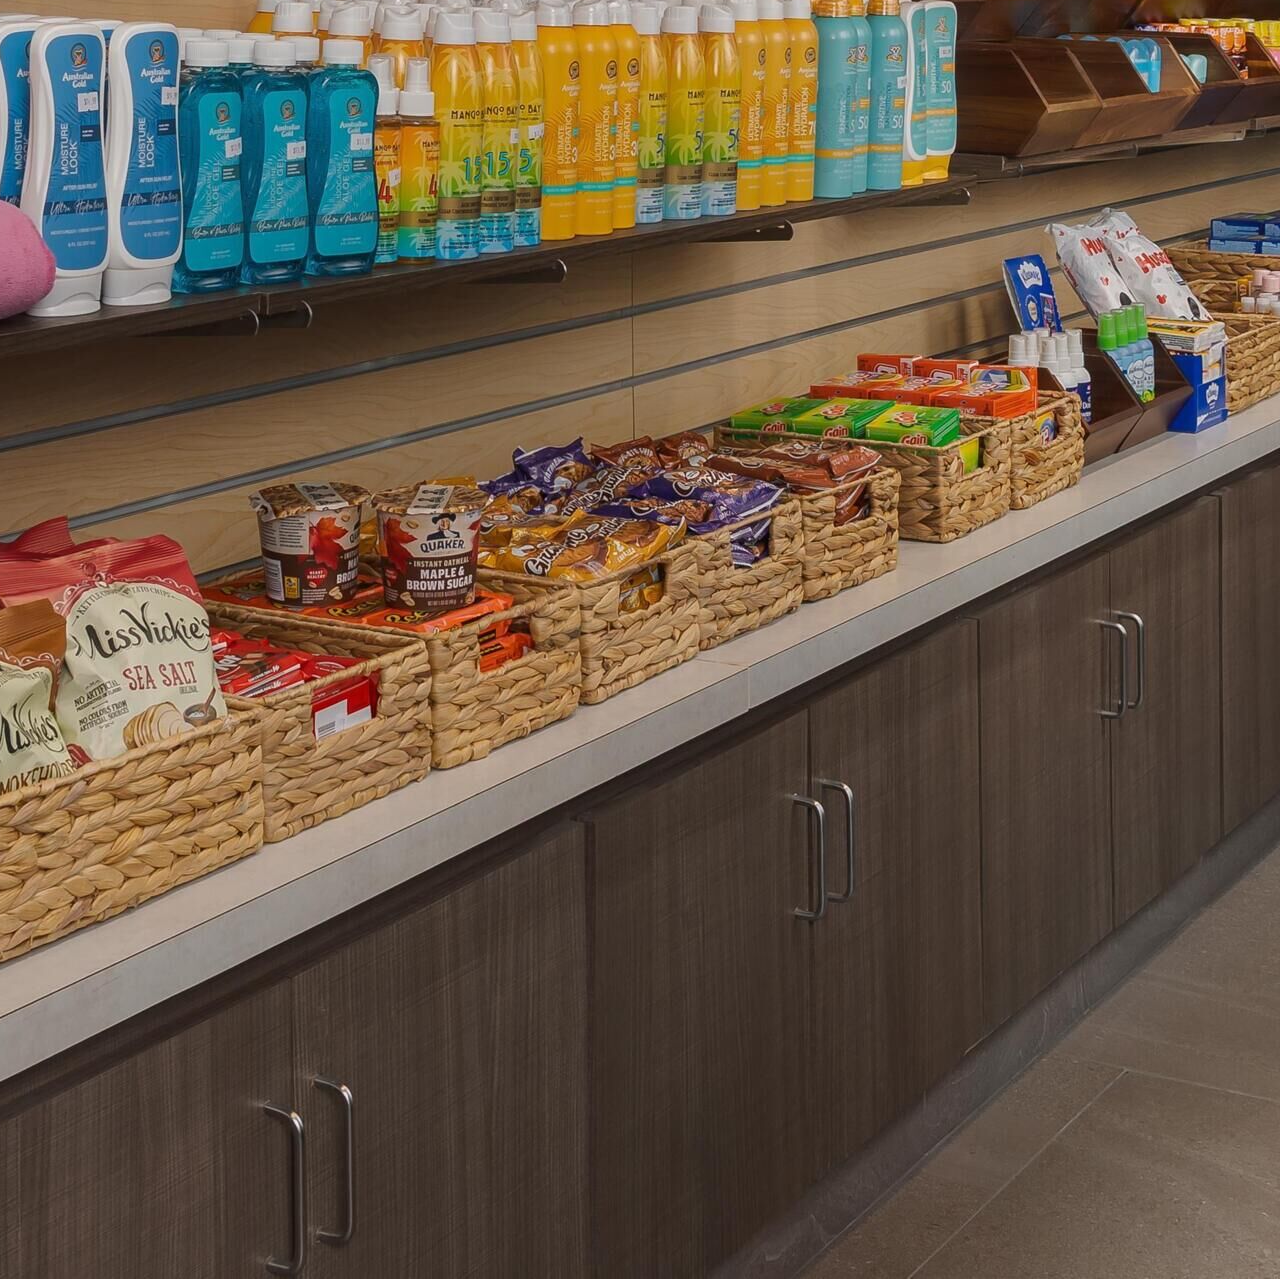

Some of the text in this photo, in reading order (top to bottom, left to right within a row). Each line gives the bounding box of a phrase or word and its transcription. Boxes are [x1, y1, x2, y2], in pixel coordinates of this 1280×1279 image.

[63, 71, 94, 83] Australian
[141, 67, 172, 79] Australian
[150, 75, 164, 85] Gold
[72, 79, 87, 89] Gold
[940, 80, 952, 94] 50
[451, 110, 480, 120] MANGO
[891, 115, 903, 130] 50
[565, 107, 573, 165] HYDRATION
[602, 105, 610, 161] HYDRATION
[15, 118, 23, 170] MOISTURE
[61, 122, 69, 176] MOISTURE
[137, 116, 146, 169] MOISTURE
[70, 142, 78, 176] LOCK
[146, 136, 155, 169] LOCK
[485, 151, 511, 176] 15
[378, 178, 392, 203] 4
[761, 423, 786, 433] Gain
[825, 426, 848, 437] Gain
[901, 434, 928, 445] Gain
[420, 539, 465, 553] QUAKER
[413, 557, 470, 568] INSTANT OATMEAL
[420, 567, 465, 580] MAPLE &
[406, 576, 473, 591] BROWN SUGAR
[123, 661, 197, 691] SEA SALT
[74, 681, 120, 707] NO ARTIFICIAL
